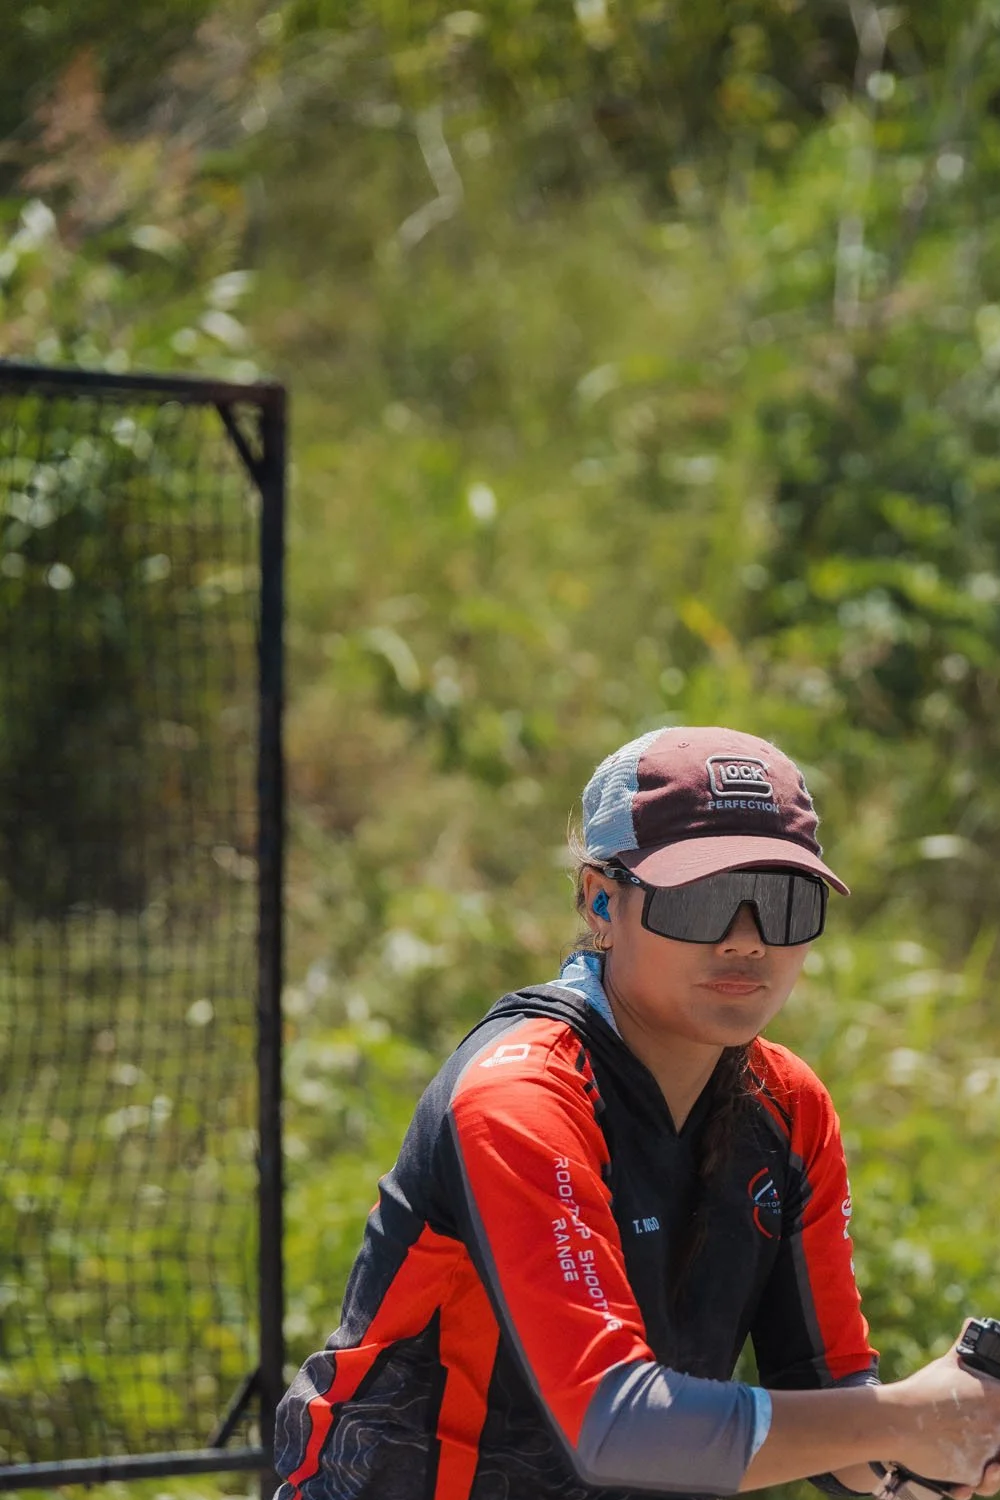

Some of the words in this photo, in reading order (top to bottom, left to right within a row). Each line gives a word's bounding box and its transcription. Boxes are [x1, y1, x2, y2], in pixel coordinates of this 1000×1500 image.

[707, 799, 780, 814] PERFECTION
[551, 1217, 579, 1282] RANGE
[578, 1249, 623, 1331] SHOOTG
